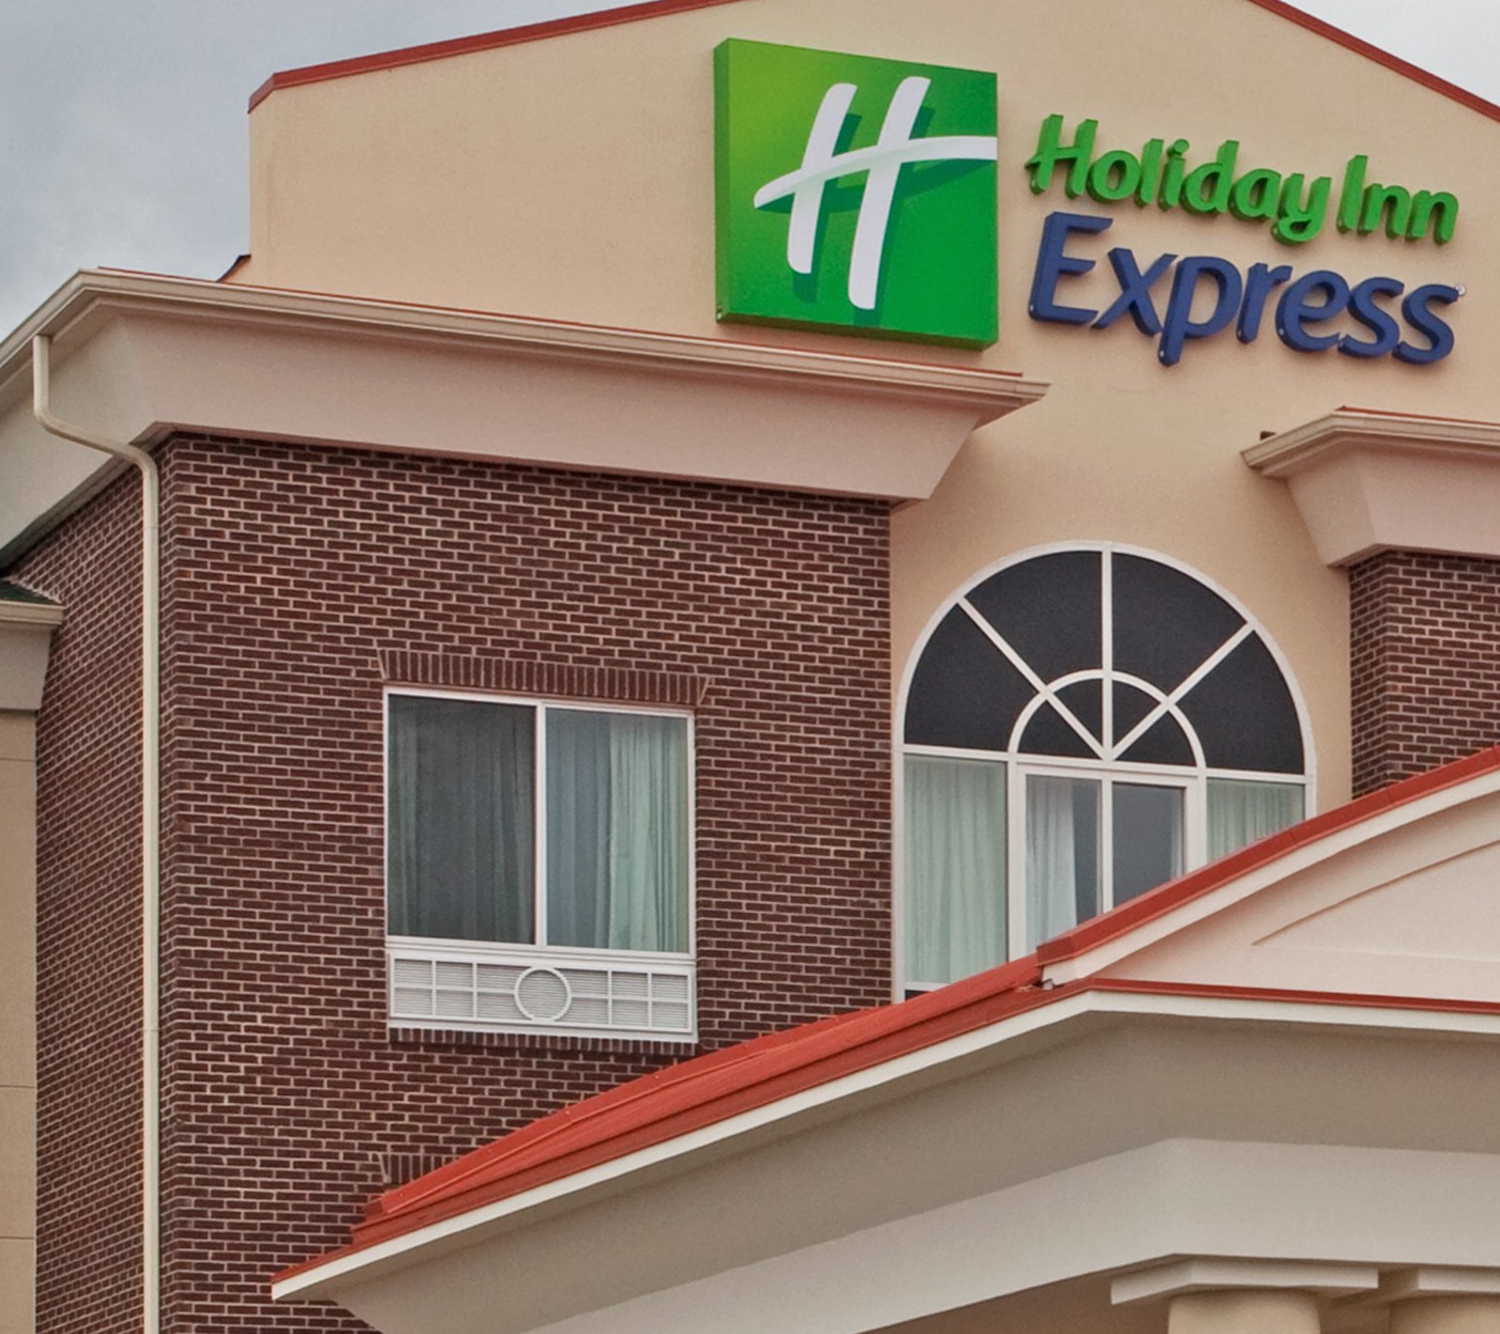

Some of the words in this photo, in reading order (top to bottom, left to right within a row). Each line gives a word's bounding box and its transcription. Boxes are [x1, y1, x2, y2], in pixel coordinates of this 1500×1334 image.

[1024, 113, 1332, 247] Holiday
[1336, 154, 1459, 245] Inn
[1028, 211, 1458, 367] Express
